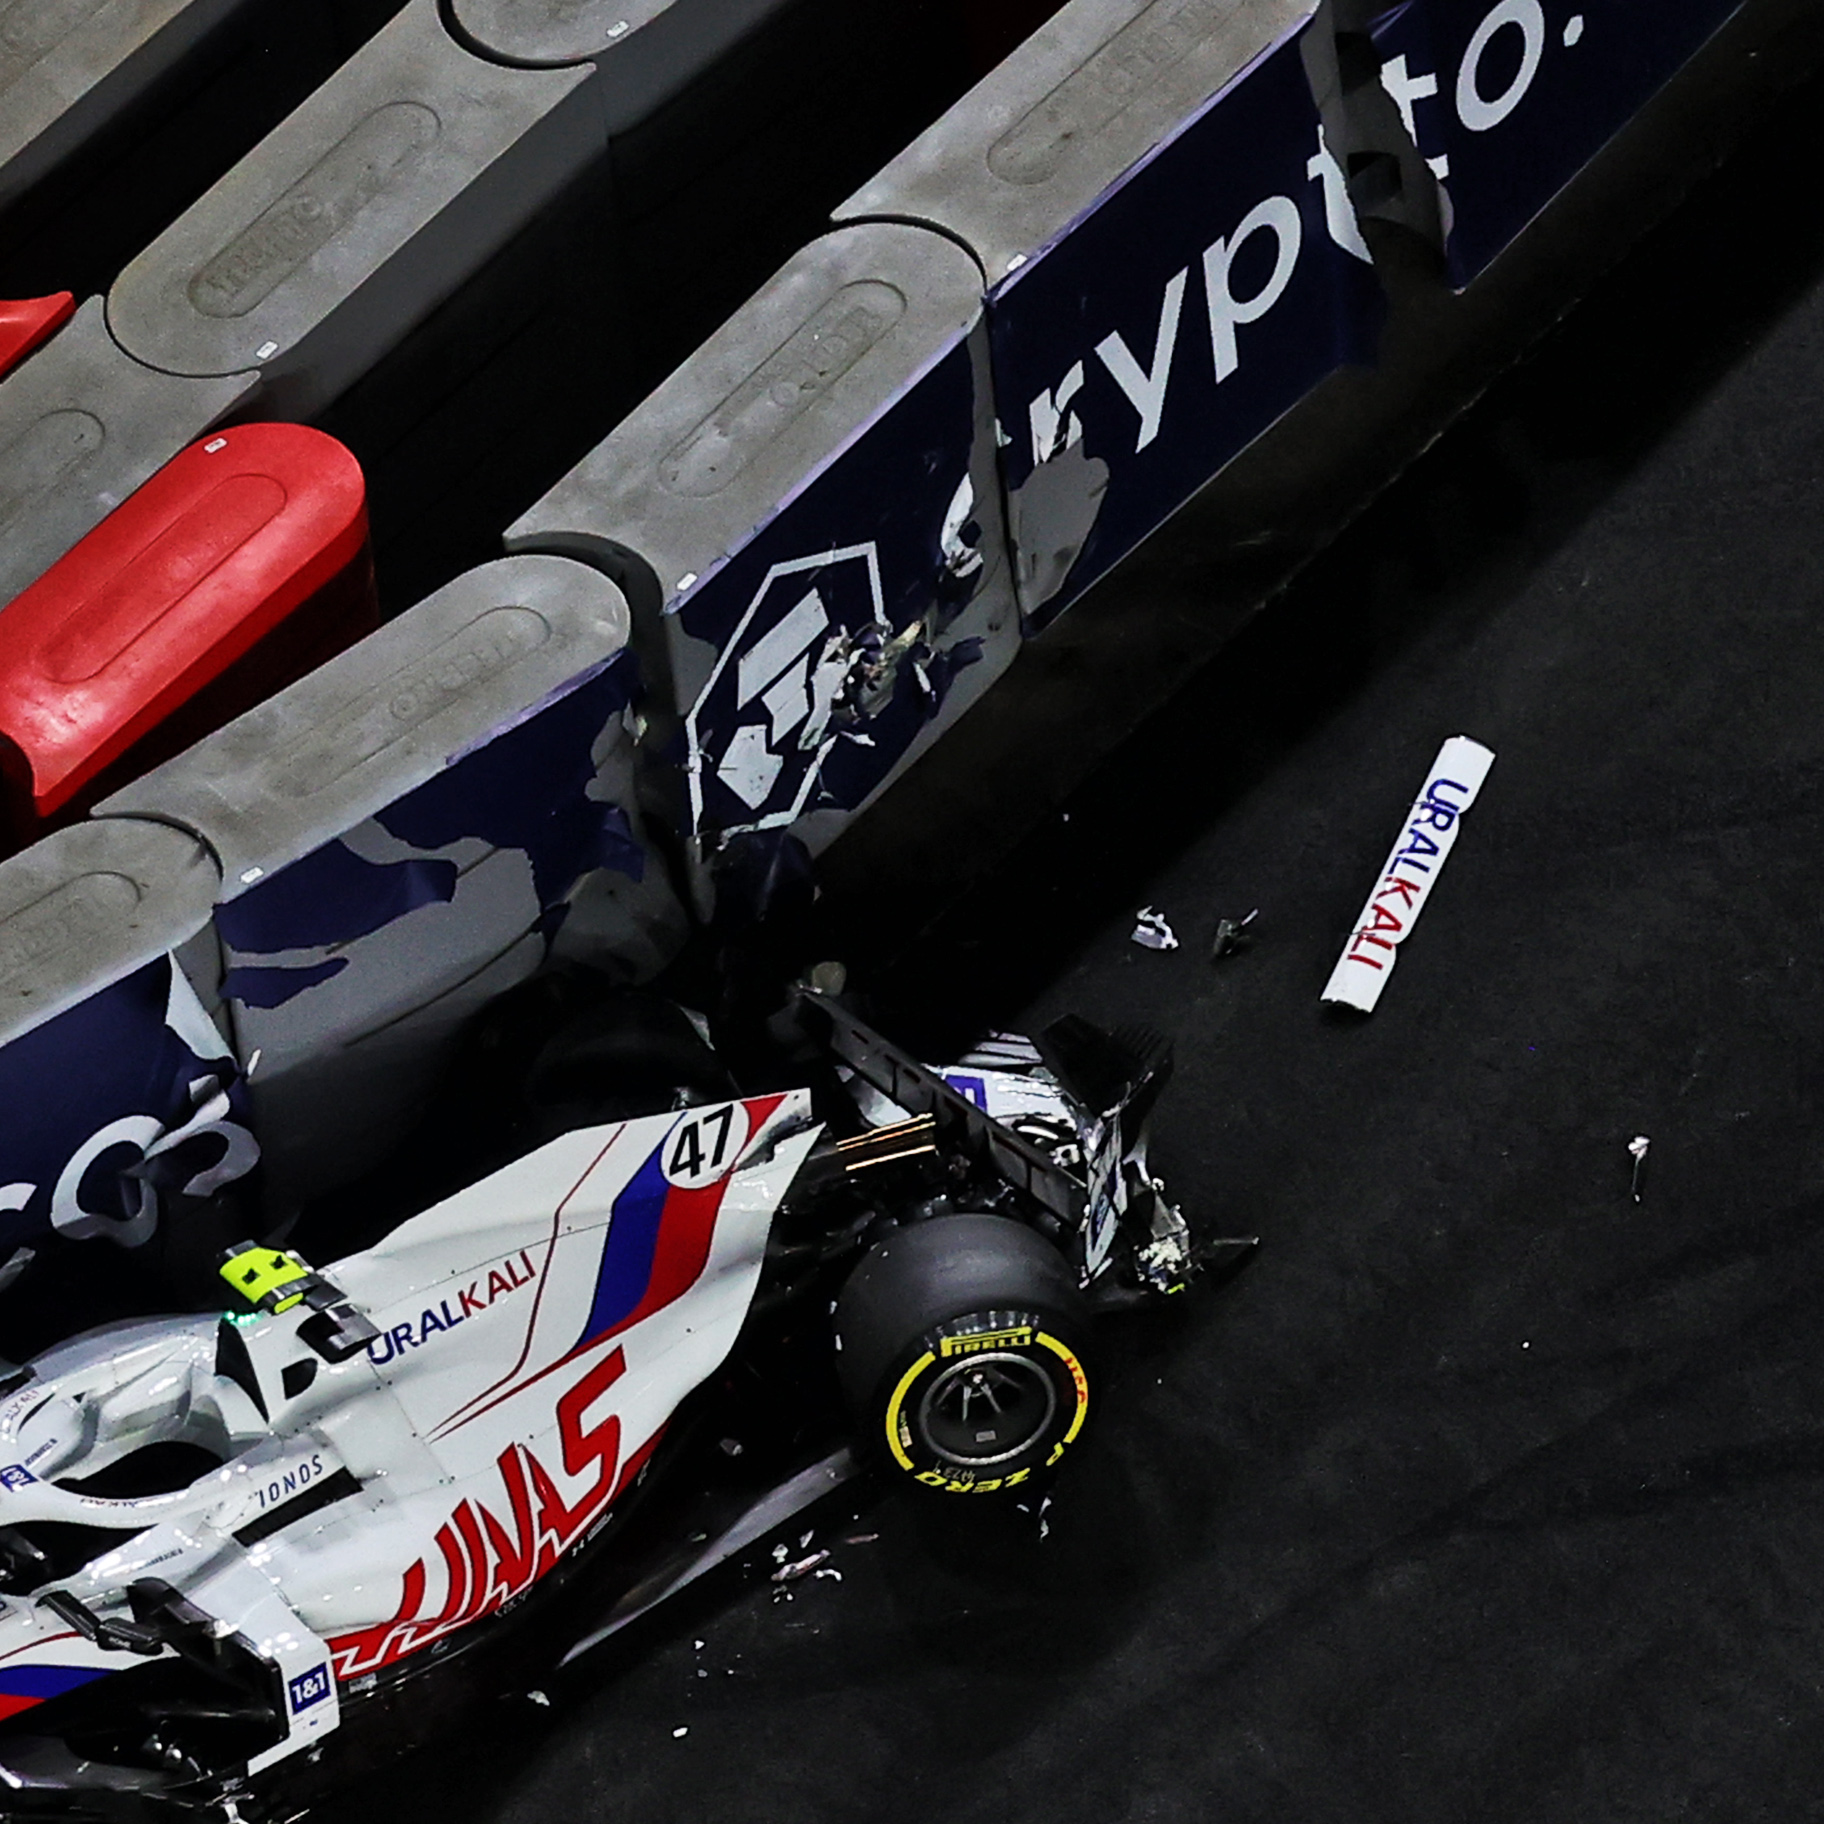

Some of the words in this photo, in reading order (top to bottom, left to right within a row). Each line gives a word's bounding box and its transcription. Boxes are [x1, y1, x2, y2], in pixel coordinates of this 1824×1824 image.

[1346, 778, 1468, 972] URALKALI
[669, 1104, 735, 1178] 47
[367, 1251, 536, 1365] URALKALI
[940, 1326, 1033, 1358] PIRELLI
[913, 1467, 1031, 1494] ZERO
[291, 1673, 328, 1704] 1&1
